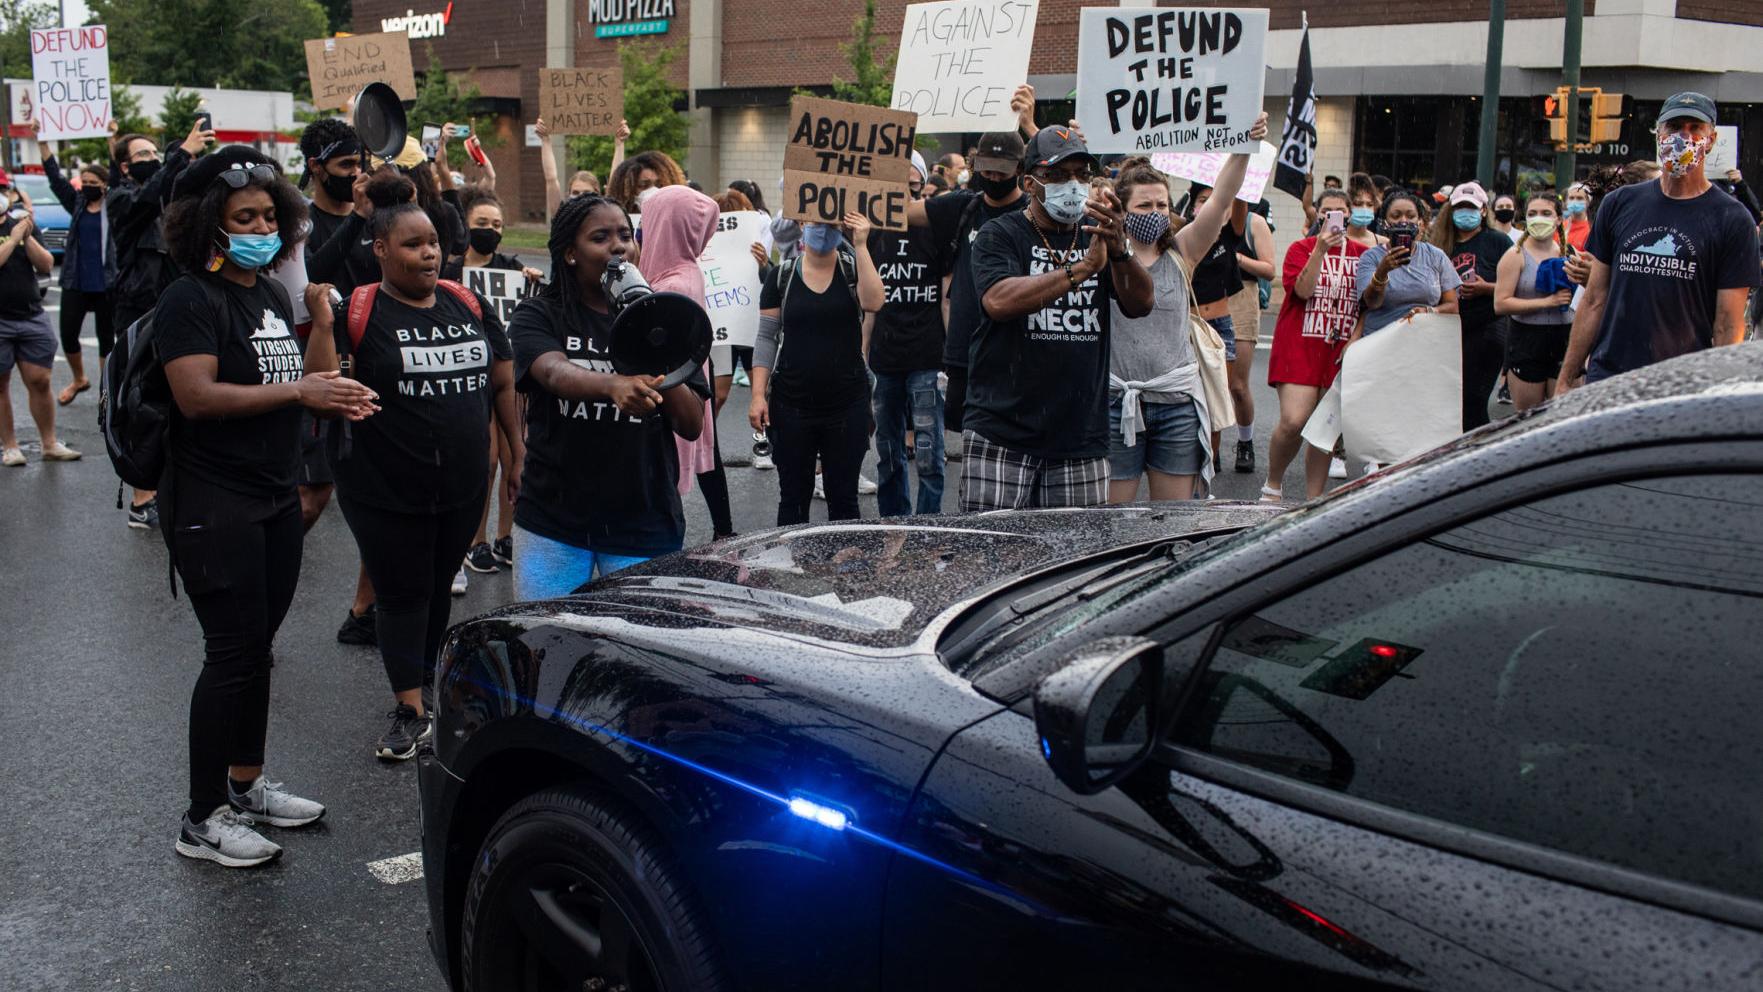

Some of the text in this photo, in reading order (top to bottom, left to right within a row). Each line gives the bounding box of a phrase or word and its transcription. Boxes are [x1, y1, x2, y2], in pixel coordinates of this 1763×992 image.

[626, 0, 674, 20] PIZZA
[381, 9, 445, 39] verizon
[600, 22, 662, 35] SUPERFAST
[910, 1, 1032, 47] AGAINST
[1105, 11, 1243, 59] DEFUND
[31, 27, 107, 54] DEFUND
[323, 41, 381, 64] END
[931, 47, 993, 80] THE
[50, 57, 90, 78] THE
[323, 61, 387, 81] Qualified
[1128, 57, 1194, 82] THE
[38, 78, 109, 104] POLICE
[551, 72, 609, 88] BLACK
[552, 93, 608, 108] LIVES
[898, 85, 1006, 118] POLICE
[1105, 85, 1228, 135] POLICE
[41, 102, 109, 133] NOW
[551, 112, 613, 130] MATTER
[791, 111, 916, 160] ABOLISH
[1135, 126, 1232, 151] ABOLITION NOT
[1608, 143, 1630, 155] 110
[816, 152, 873, 176] THE
[798, 182, 905, 228] POLICE
[896, 239, 910, 256] I
[1623, 226, 1668, 248] DEMOCRACY
[1678, 232, 1697, 256] ACTION
[878, 262, 928, 280] CAN'T
[1619, 252, 1697, 274] INDIVISIBLE
[1619, 264, 1695, 280] CHARLOTTESVILLE
[883, 285, 938, 303] EATHE
[1067, 289, 1096, 306] MY
[1027, 307, 1101, 333] NECK
[395, 323, 478, 342] BLACK
[1031, 332, 1099, 342] ENOUGH IS ENOUGH
[411, 346, 483, 366] LIVES
[398, 373, 488, 397] MATTER
